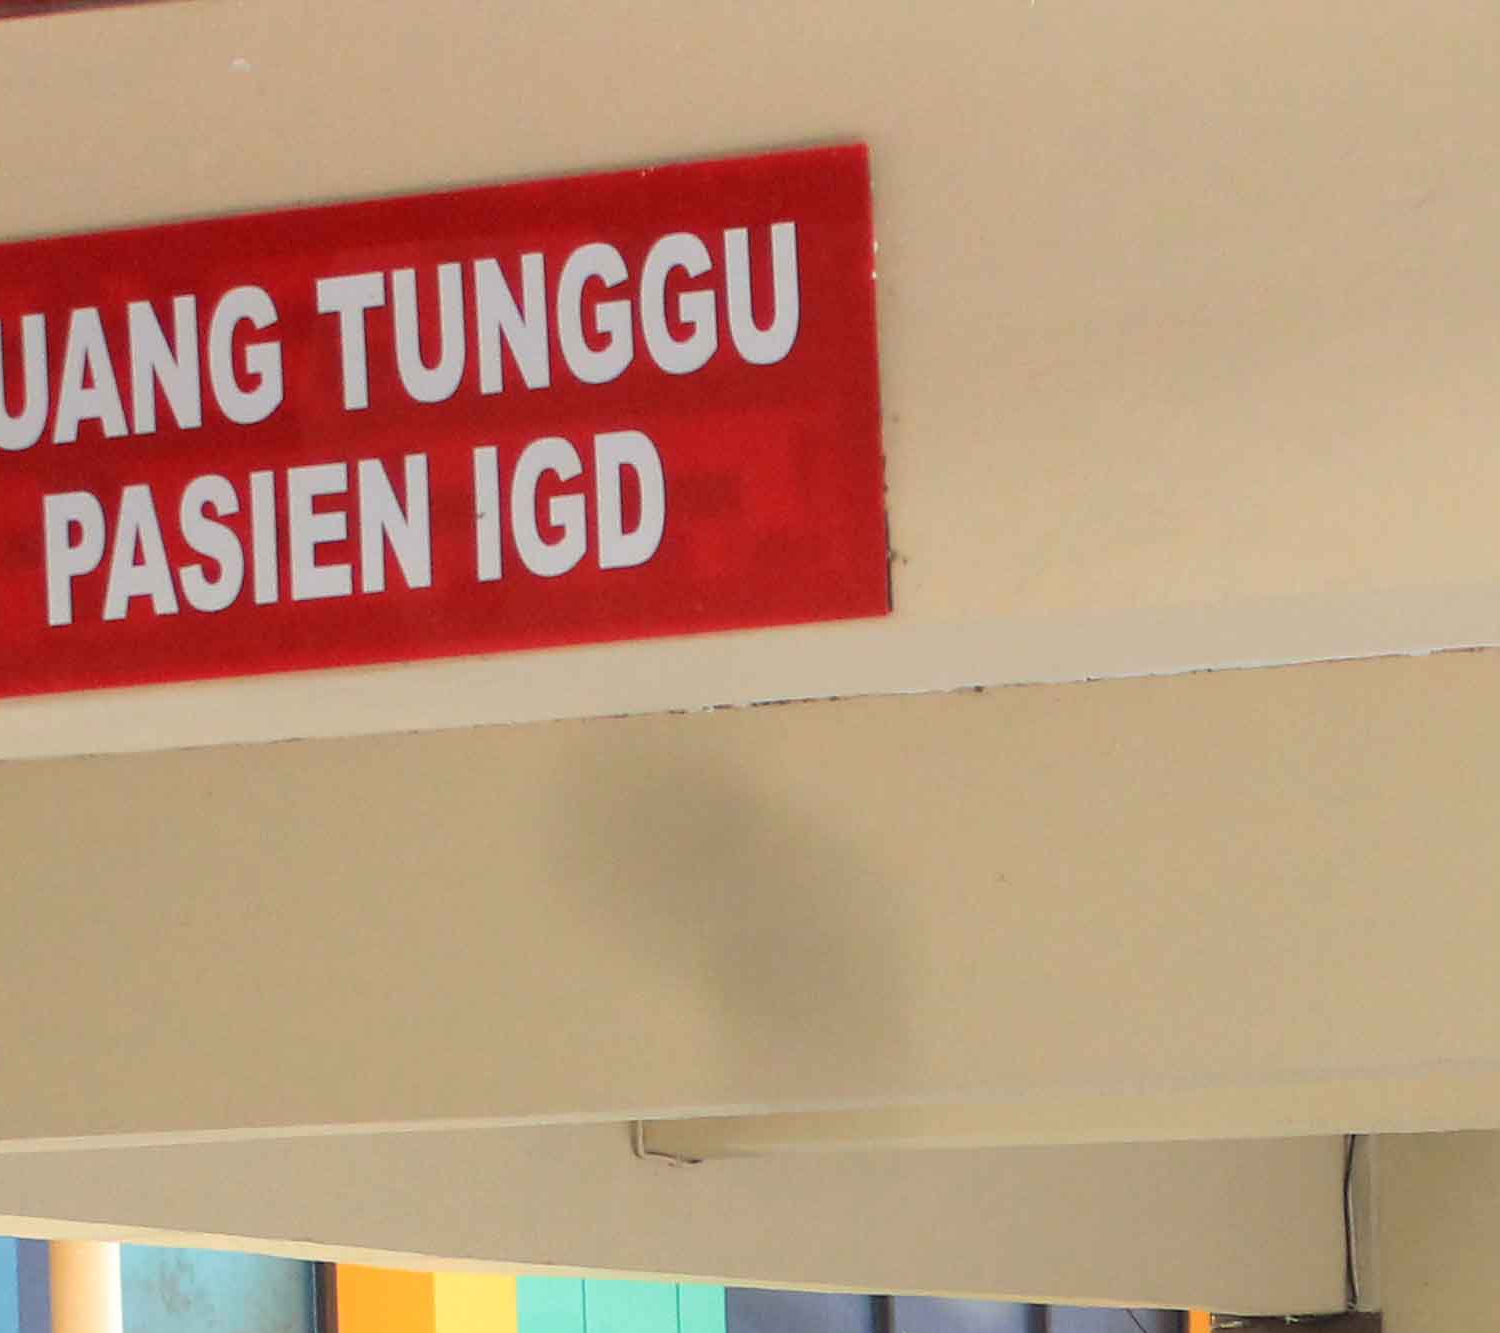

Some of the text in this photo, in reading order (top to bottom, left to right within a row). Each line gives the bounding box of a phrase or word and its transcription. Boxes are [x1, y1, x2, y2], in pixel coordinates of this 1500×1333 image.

[316, 220, 800, 411] TUNGGU
[41, 429, 666, 628] PASIEN IGD
